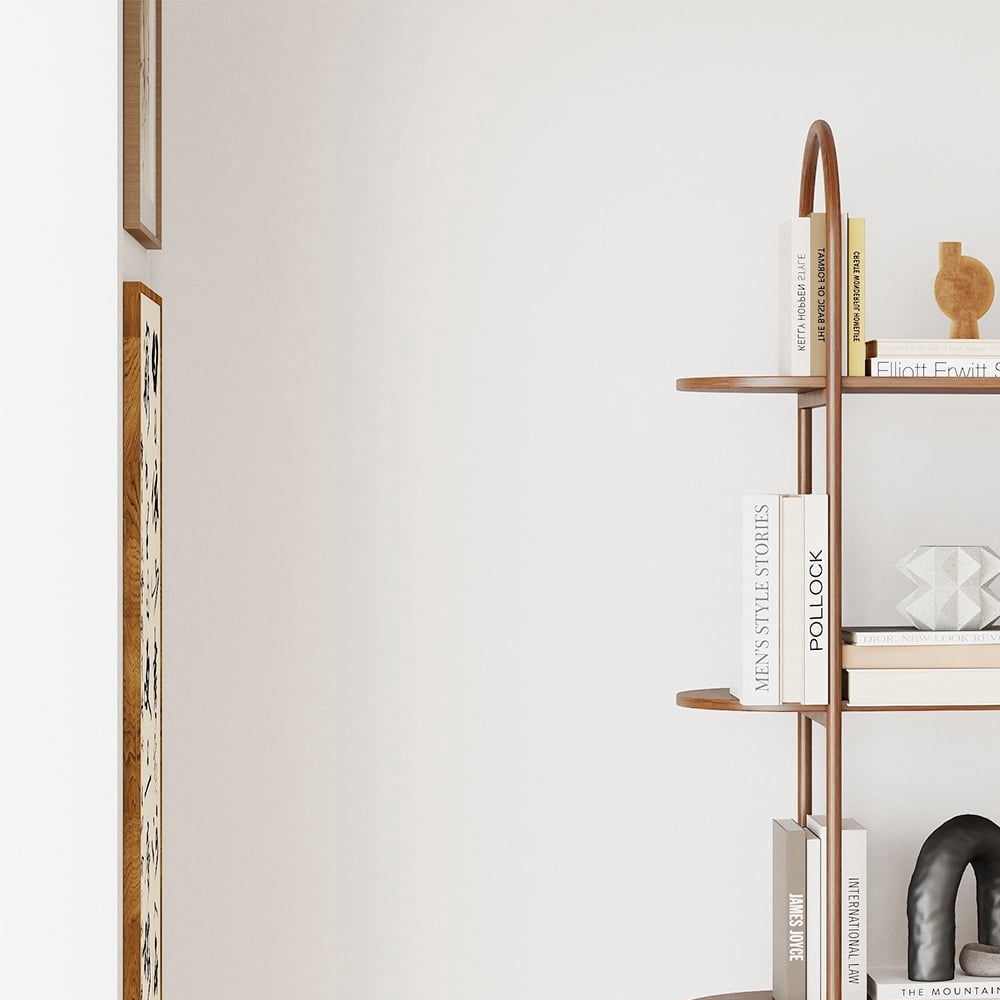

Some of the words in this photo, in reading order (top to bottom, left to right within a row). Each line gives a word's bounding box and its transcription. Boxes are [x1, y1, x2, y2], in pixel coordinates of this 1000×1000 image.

[754, 504, 769, 577] STORIES
[754, 581, 769, 635] STYLE
[809, 549, 823, 651] POLLOCK
[901, 633, 932, 643] NEW
[934, 633, 970, 642] LOOK
[789, 893, 803, 927] JAMES
[848, 877, 860, 959] INTERNATIONAL
[789, 930, 803, 961] JOYCE
[848, 963, 860, 984] LAW
[901, 988, 924, 997] THE
